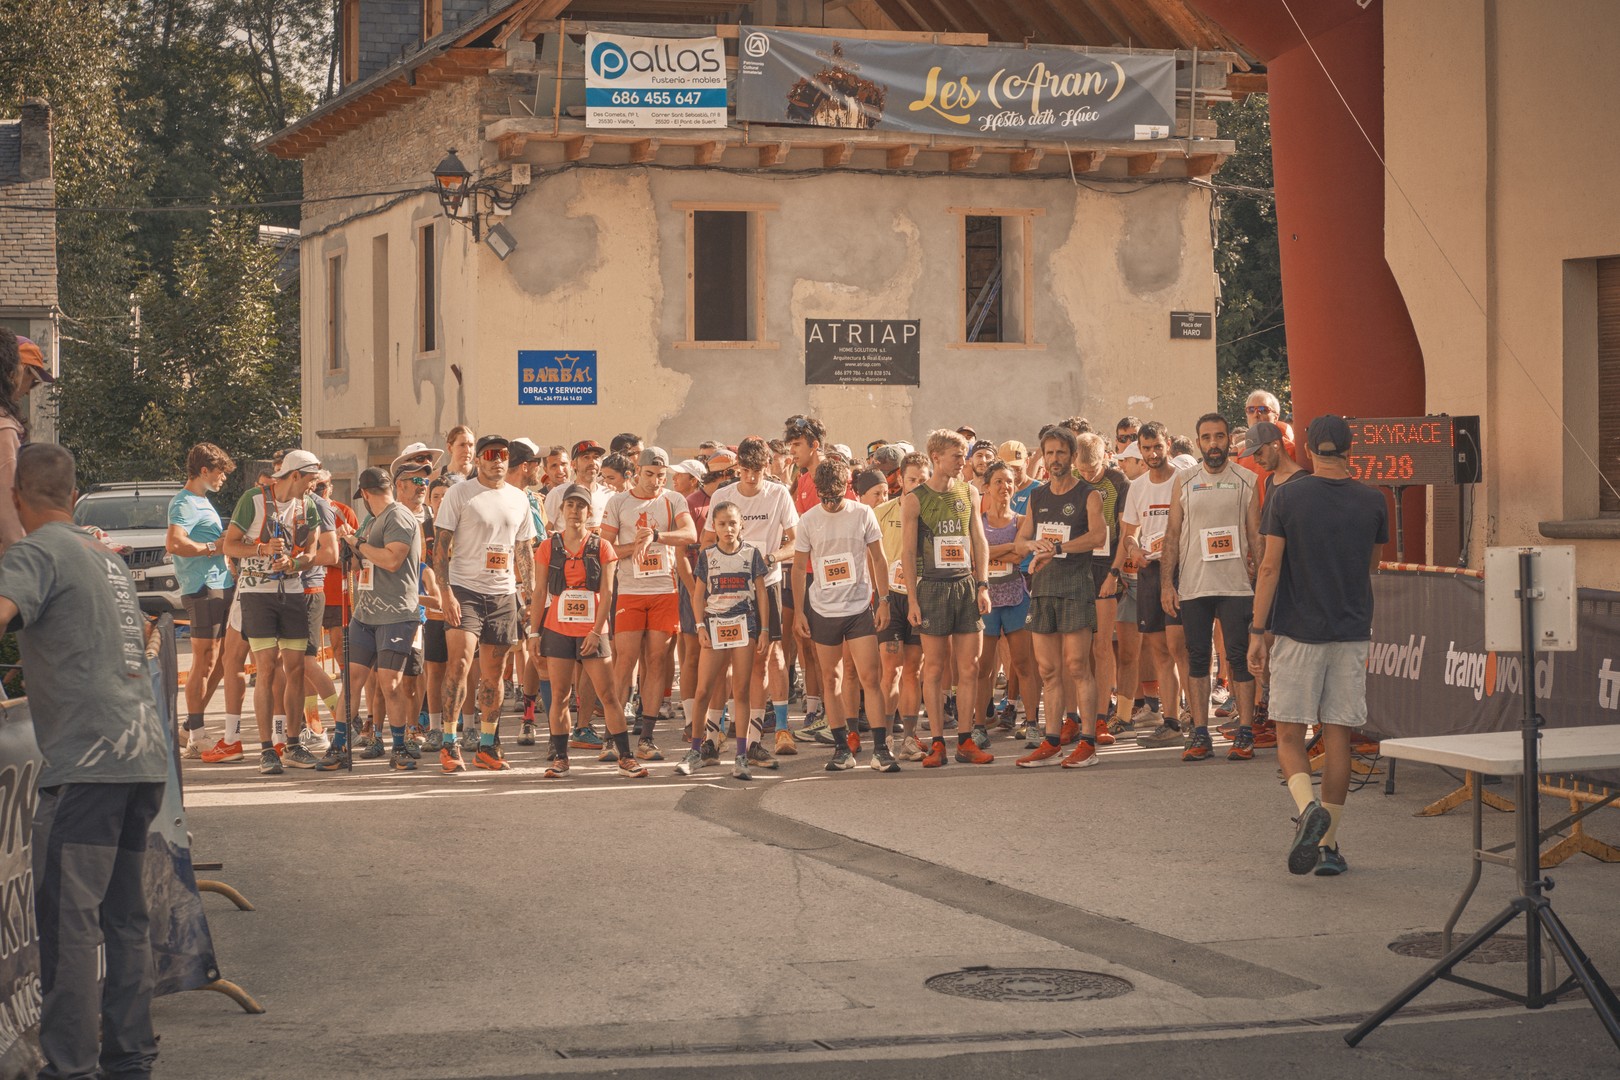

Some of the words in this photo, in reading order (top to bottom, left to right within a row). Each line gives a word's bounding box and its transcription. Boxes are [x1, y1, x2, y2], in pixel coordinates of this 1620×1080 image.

[651, 76, 686, 84] Fusteria
[692, 75, 721, 84] mobles
[611, 91, 640, 105] 686
[644, 92, 671, 105] 455
[675, 92, 702, 105] 647
[908, 66, 981, 124] Les
[1028, 109, 1056, 126] deth
[808, 323, 917, 344] ATRIAP
[523, 386, 548, 394] OBRAS
[555, 386, 593, 394] SERVICIOS
[1363, 423, 1442, 444] SKYRACE
[1349, 453, 1414, 480] 57:28
[937, 518, 962, 534] 1584
[1211, 539, 1230, 548] 453
[945, 549, 961, 557] 381
[489, 556, 506, 564] 425
[643, 558, 658, 566] 418
[828, 566, 847, 576] 396
[567, 603, 586, 611] 349
[720, 628, 739, 637] 320
[1365, 634, 1427, 680] world
